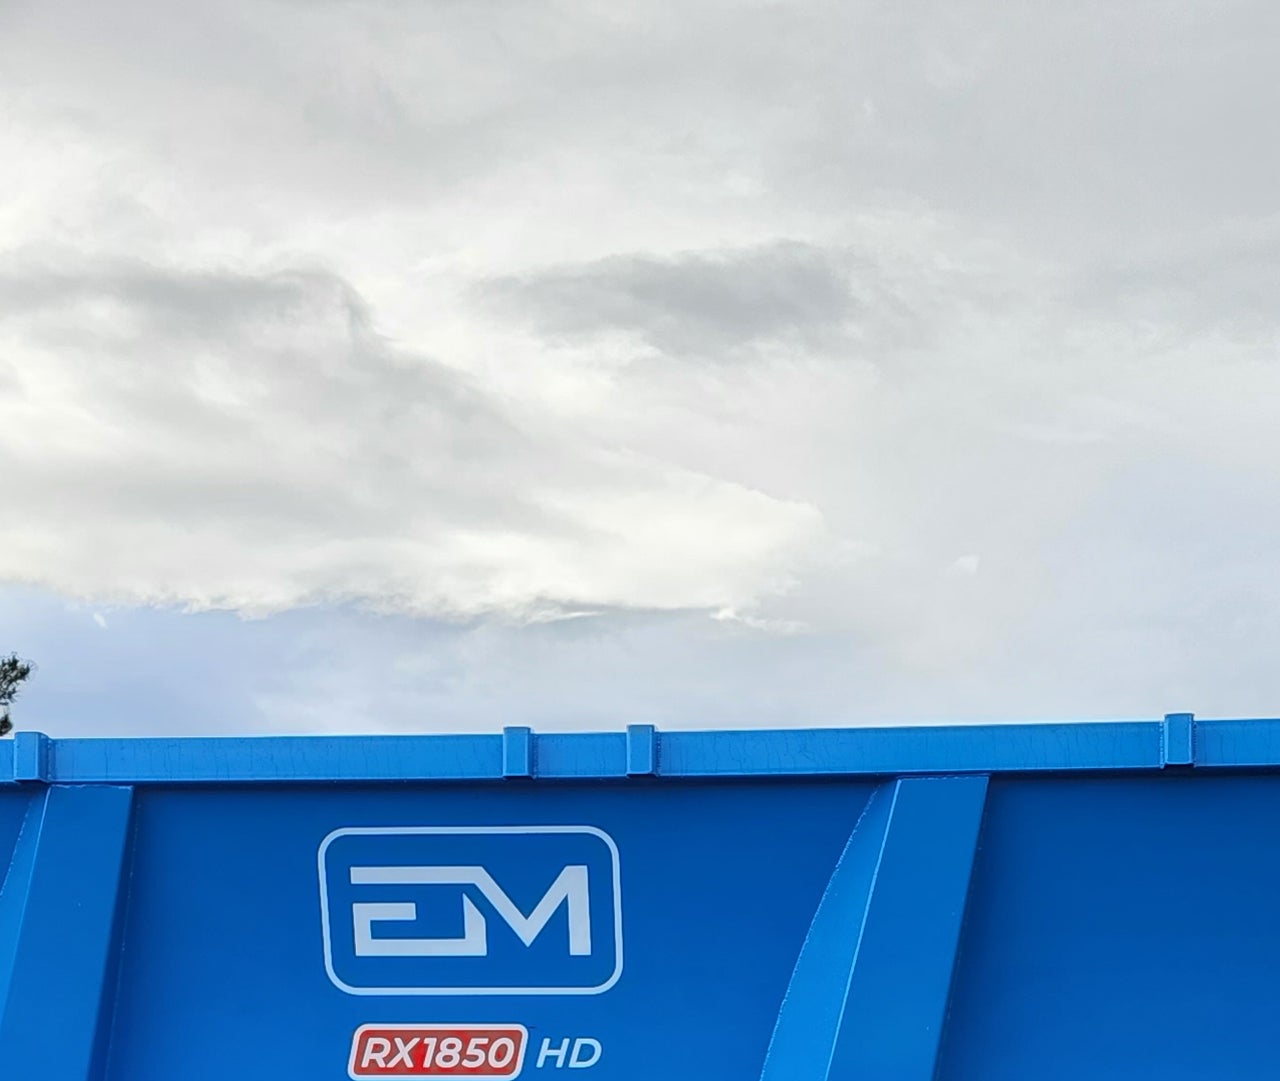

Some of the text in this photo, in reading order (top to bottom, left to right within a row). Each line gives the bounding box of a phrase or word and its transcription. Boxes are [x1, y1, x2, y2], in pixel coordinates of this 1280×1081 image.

[350, 865, 592, 956] EM
[360, 1037, 602, 1069] RX1850 HD
